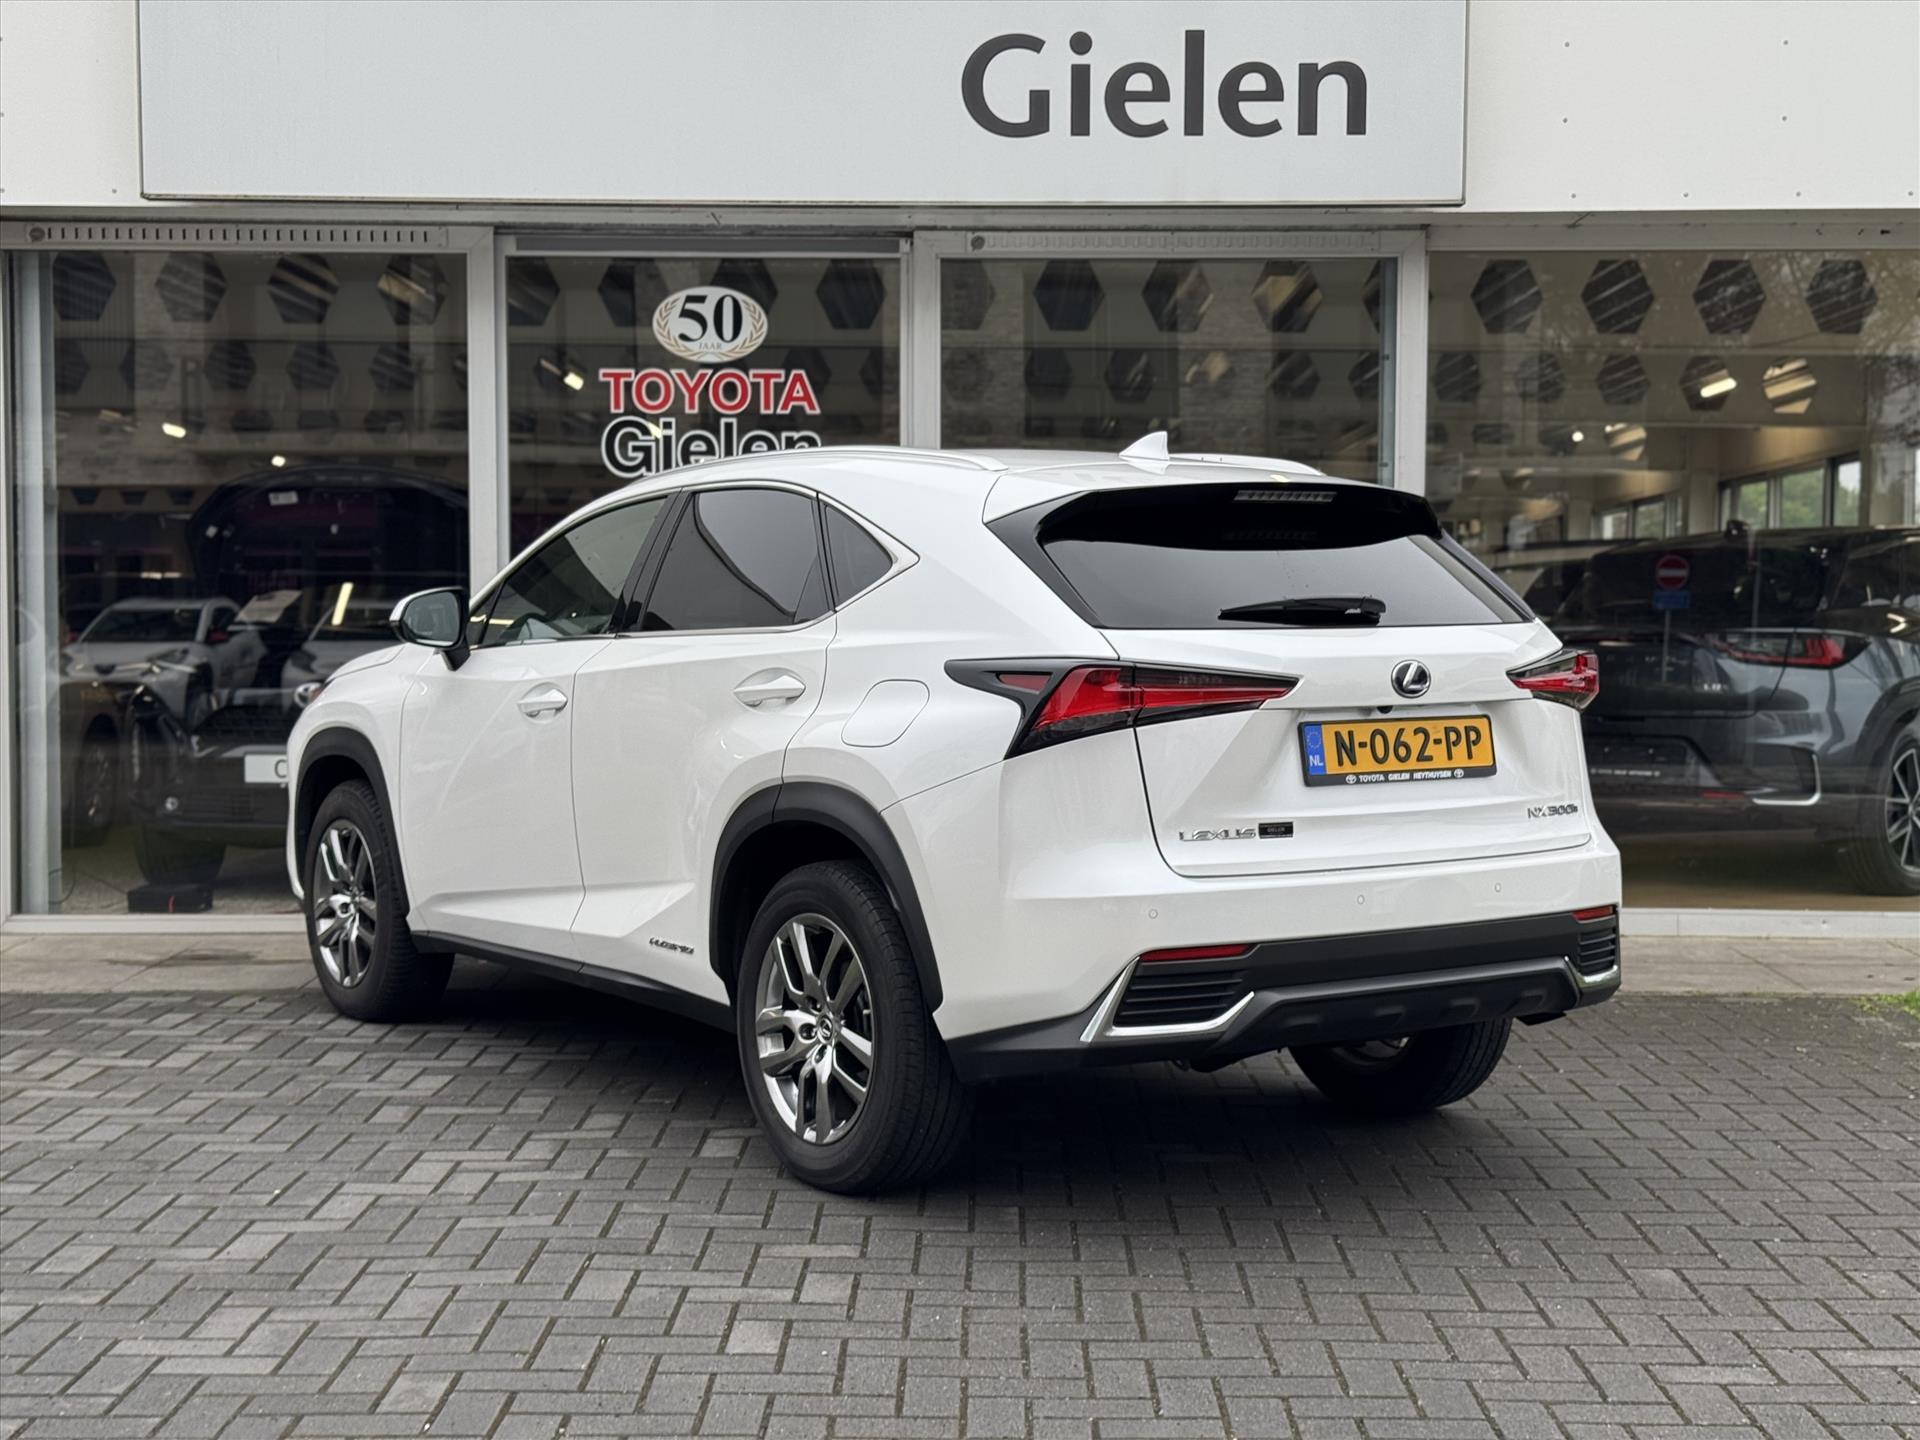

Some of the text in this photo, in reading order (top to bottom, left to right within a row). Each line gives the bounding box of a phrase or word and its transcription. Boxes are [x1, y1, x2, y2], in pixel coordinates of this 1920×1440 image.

[961, 29, 1368, 138] Gielen
[677, 294, 743, 343] 50
[698, 342, 722, 350] JAAR
[600, 369, 820, 414] TOYOTA
[1334, 725, 1482, 767] N-062-PP
[1309, 754, 1324, 767] NL
[1358, 773, 1385, 783] TOYOTA
[1388, 772, 1410, 781] GIELEN
[1178, 828, 1257, 842] LEXUS
